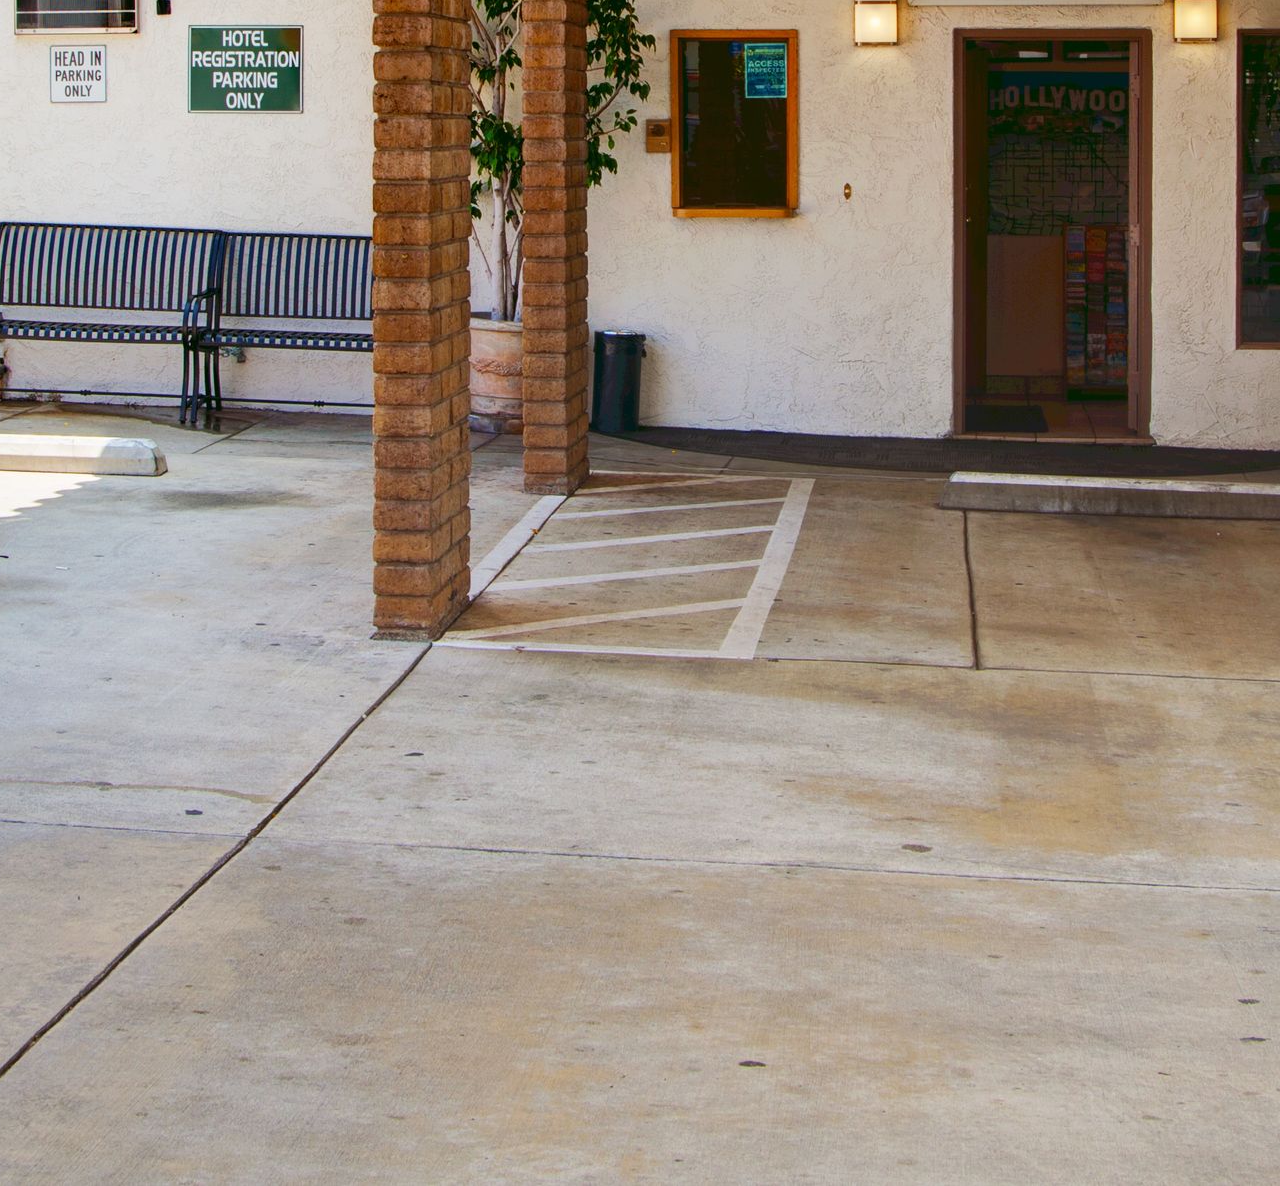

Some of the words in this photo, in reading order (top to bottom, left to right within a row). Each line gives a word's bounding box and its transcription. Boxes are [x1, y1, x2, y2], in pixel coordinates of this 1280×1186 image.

[222, 30, 269, 47] HOTEL
[54, 50, 85, 67] HEAD
[90, 50, 102, 66] IN
[191, 50, 299, 68] REGISTRATION
[748, 59, 785, 68] ACCESS
[55, 69, 102, 81] PARKING
[212, 71, 278, 89] PARKING
[64, 84, 93, 97] ONLY
[989, 84, 1128, 113] HOLLYWOO
[225, 92, 265, 109] ONLY
